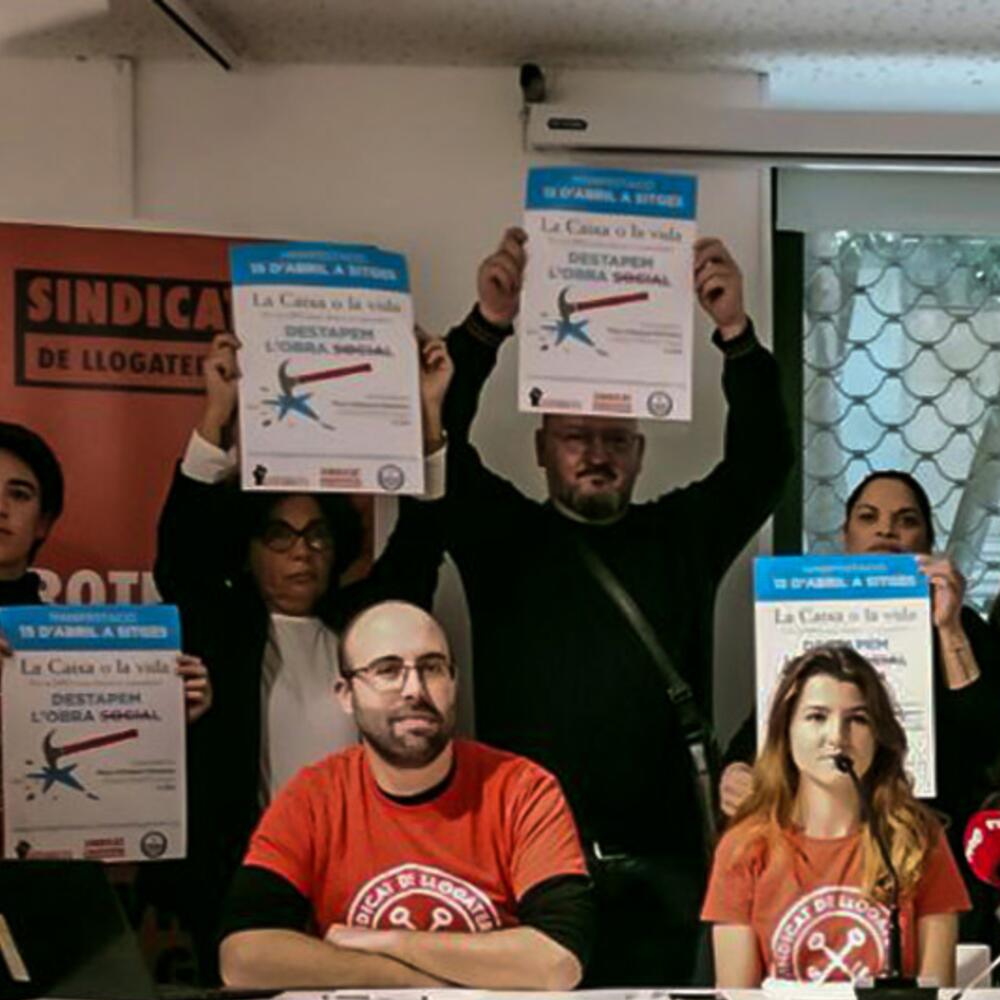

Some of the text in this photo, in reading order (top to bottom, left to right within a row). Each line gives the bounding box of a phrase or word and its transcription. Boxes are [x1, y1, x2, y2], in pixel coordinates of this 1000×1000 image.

[541, 217, 559, 233] La
[568, 252, 655, 268] DESTAPEM
[26, 276, 233, 331] SINDICA
[253, 292, 273, 308] La
[285, 325, 375, 340] DESTAPEM
[37, 347, 70, 370] DE
[774, 608, 796, 624] La
[39, 625, 99, 639] D'ABRIL
[103, 626, 115, 638] A
[20, 658, 169, 675] La Caixa o la vida
[51, 692, 142, 706] DESTAPEM
[31, 709, 95, 724] L'OBRA
